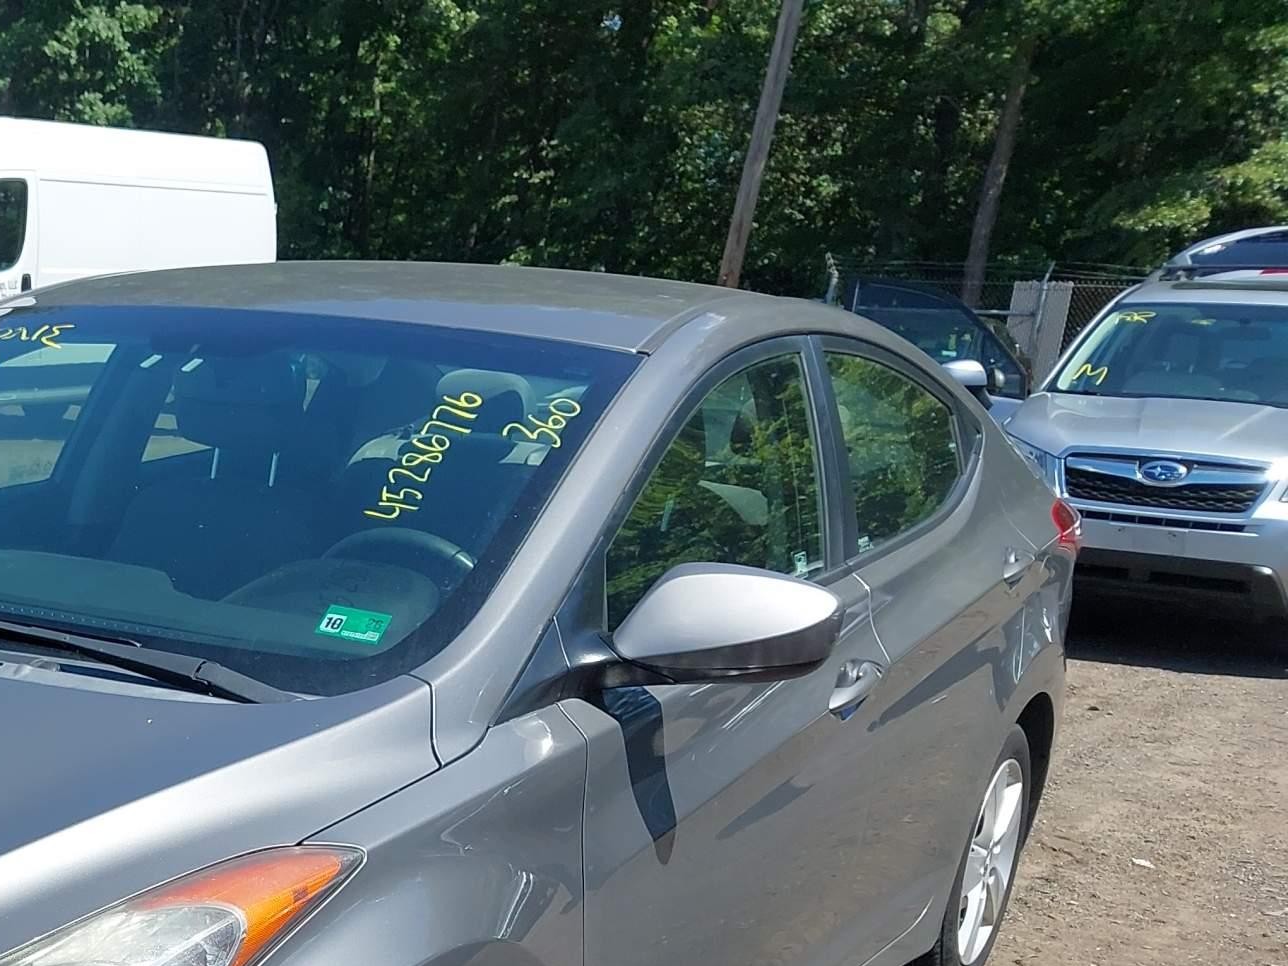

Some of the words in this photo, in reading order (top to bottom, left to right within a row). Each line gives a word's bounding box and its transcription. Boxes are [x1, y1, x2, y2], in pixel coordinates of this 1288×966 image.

[502, 398, 581, 448] 360
[363, 392, 483, 519] 45286776
[324, 617, 344, 630] 10
